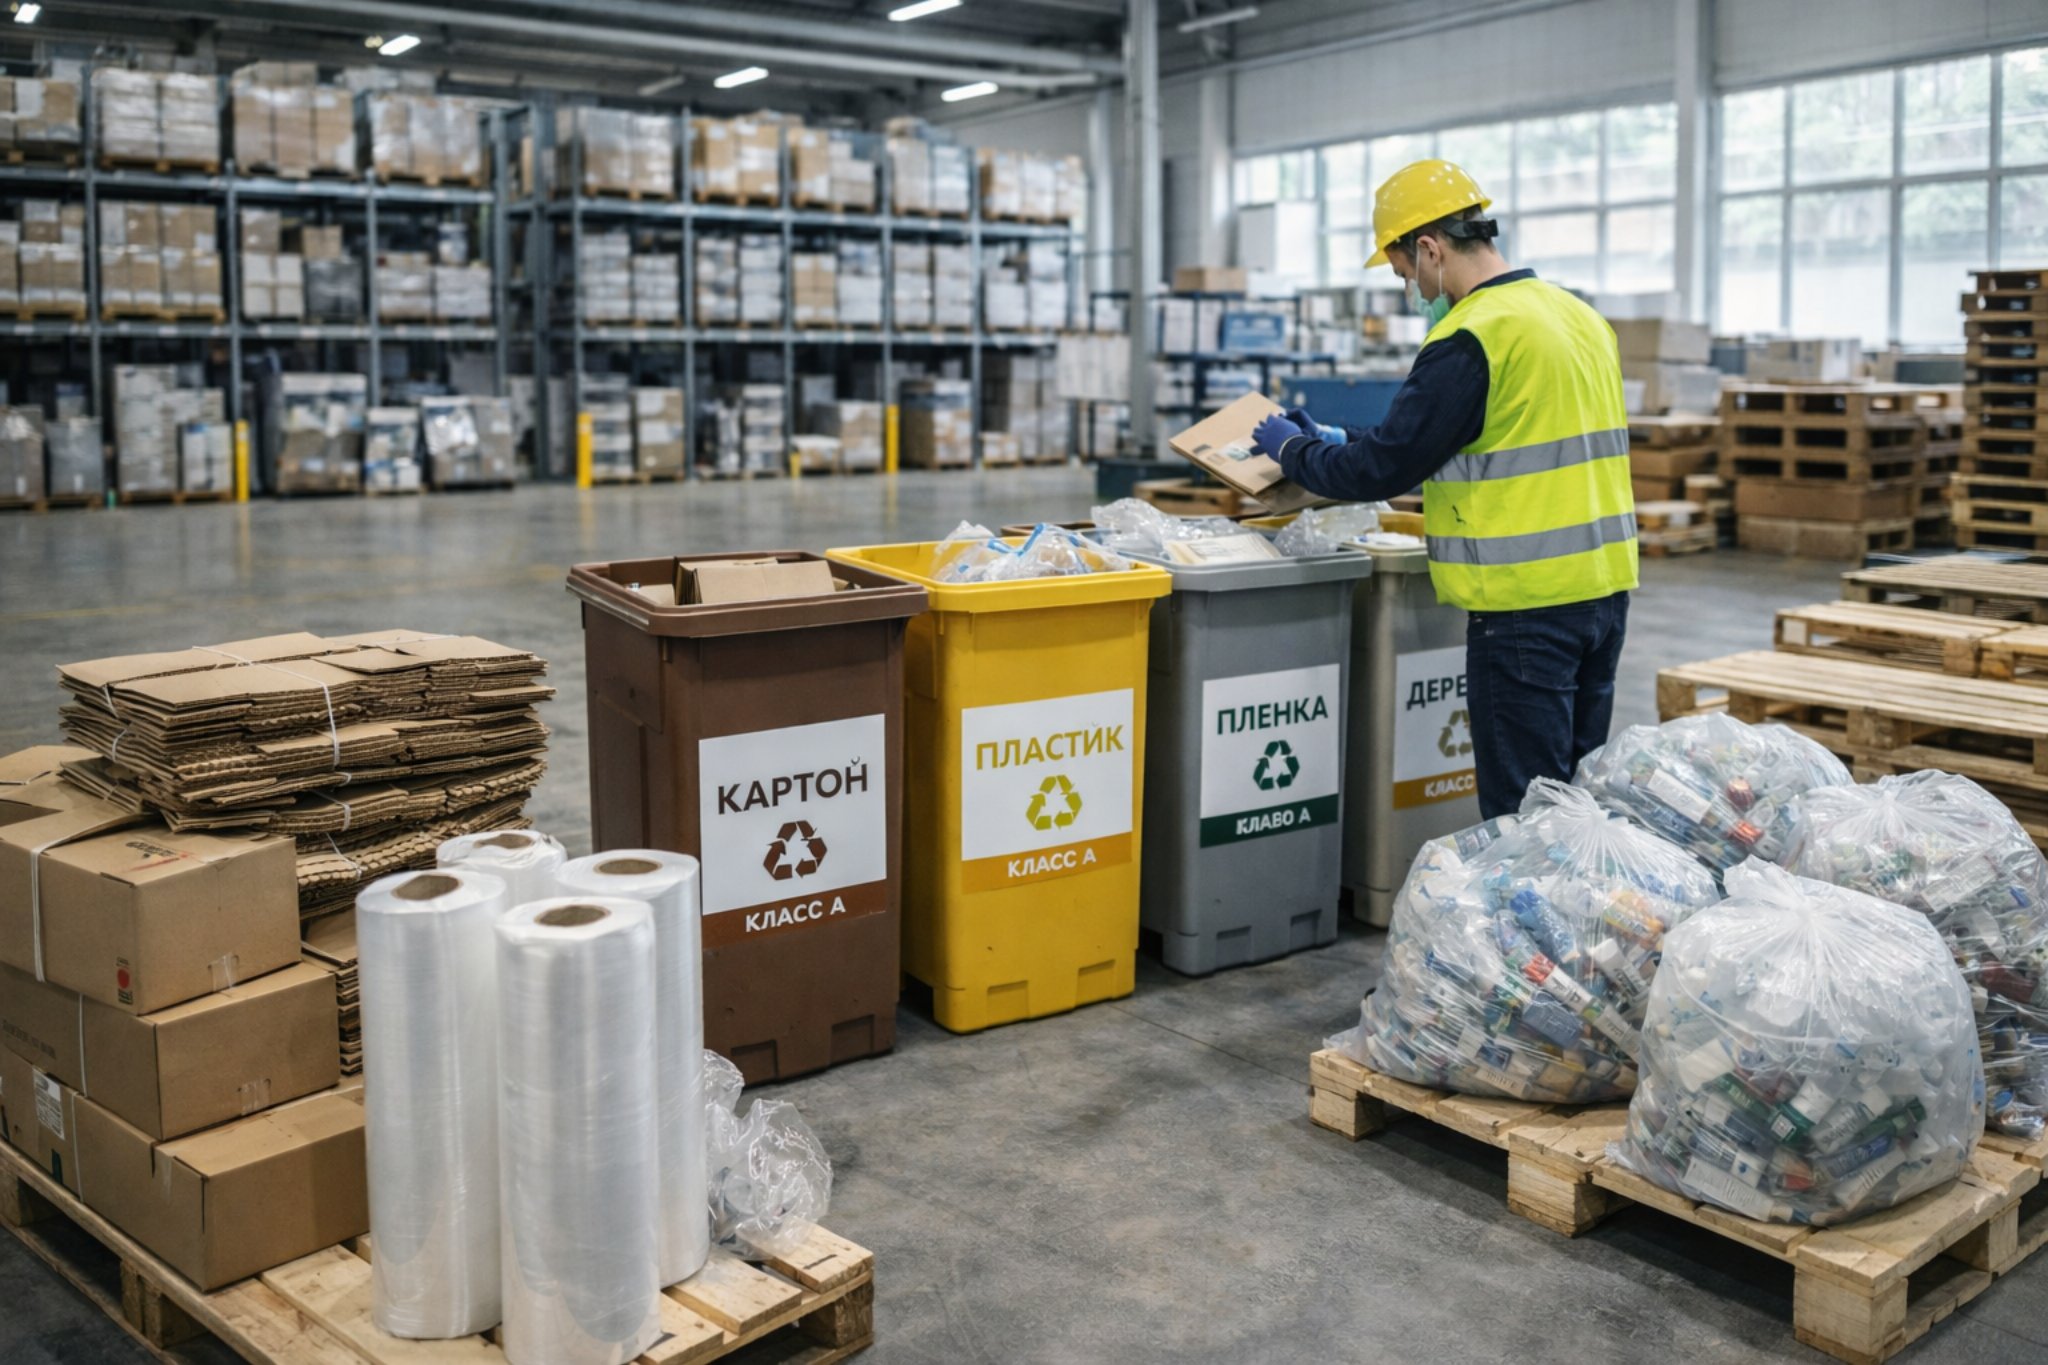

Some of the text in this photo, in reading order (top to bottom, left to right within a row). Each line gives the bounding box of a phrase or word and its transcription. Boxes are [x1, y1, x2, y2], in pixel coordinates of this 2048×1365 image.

[1406, 674, 1467, 711] ДЕРЕ
[1217, 695, 1328, 735] ПЛЕНКА
[1299, 807, 1312, 824] А
[1008, 848, 1097, 878] КЛАСС А
[745, 896, 846, 933] КЛАСС А
